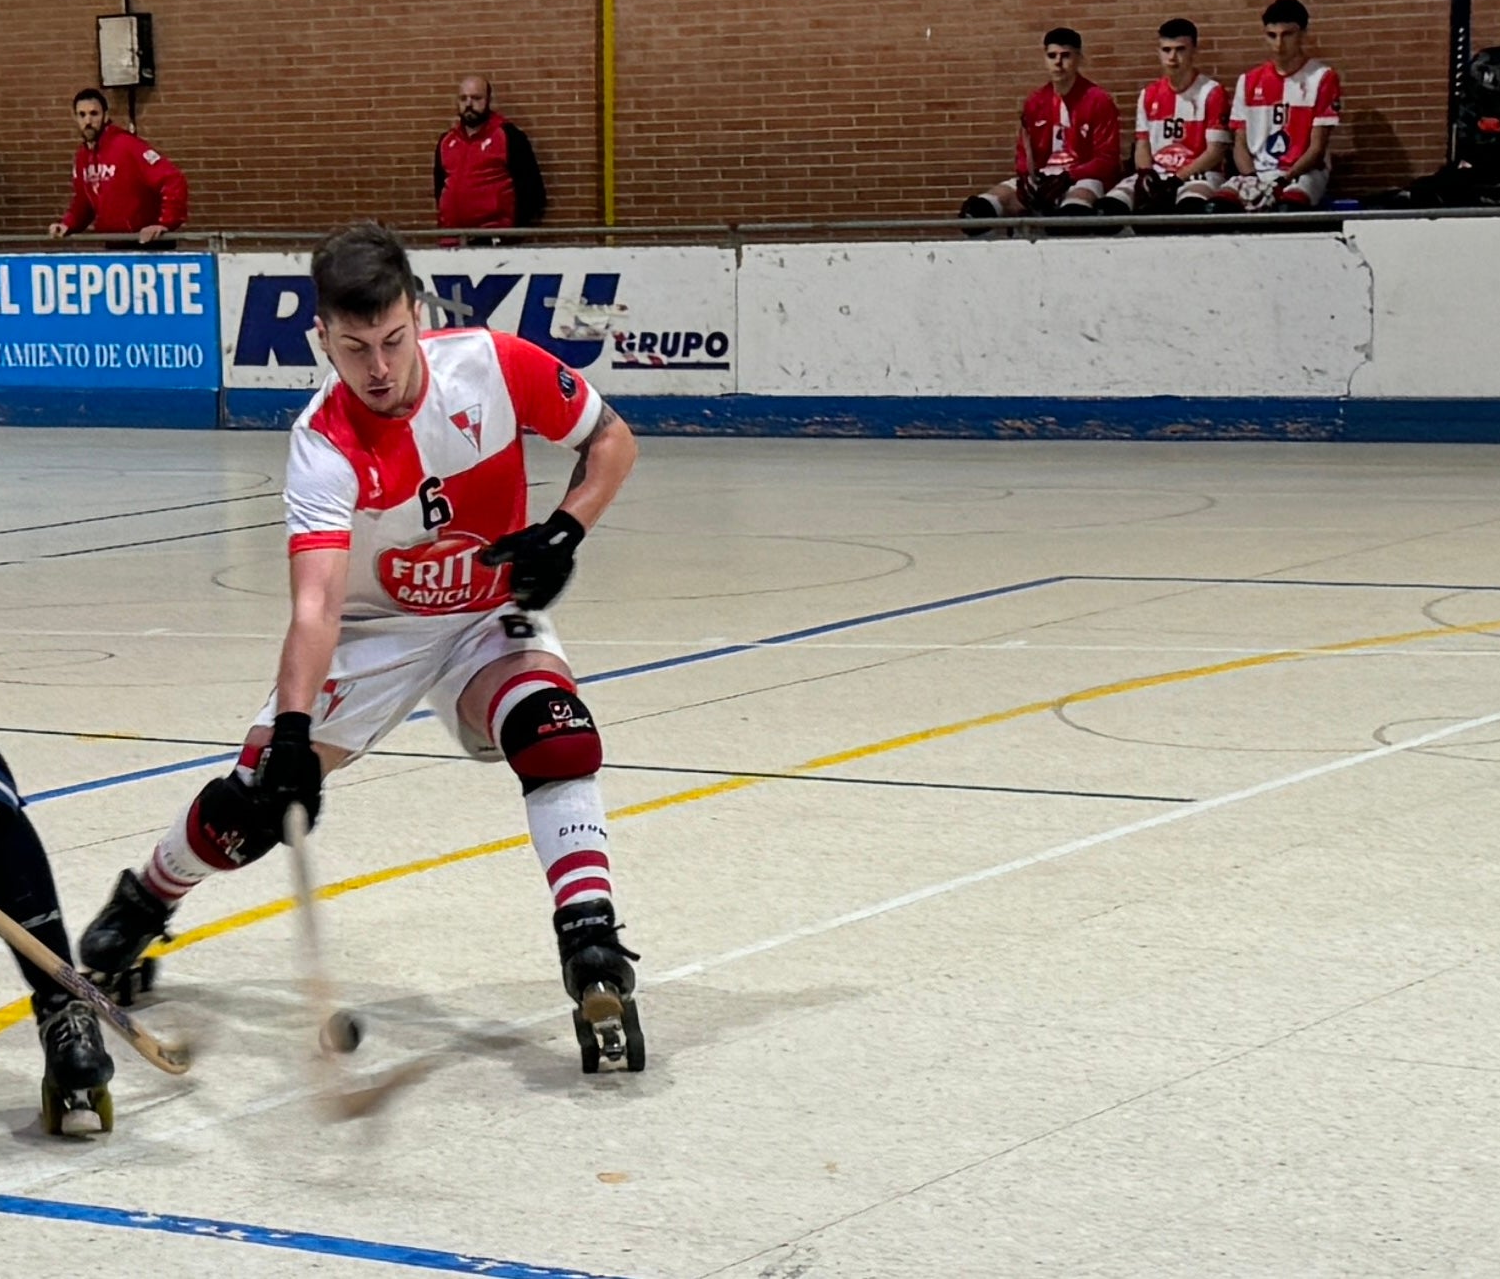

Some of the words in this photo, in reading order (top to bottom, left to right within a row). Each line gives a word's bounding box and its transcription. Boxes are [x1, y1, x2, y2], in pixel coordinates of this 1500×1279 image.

[1163, 117, 1185, 139] 66
[31, 262, 204, 316] DEPORTE
[95, 342, 121, 368] DE
[125, 342, 204, 368] OVIEDO
[418, 476, 452, 531] 6
[391, 545, 481, 590] FRIT
